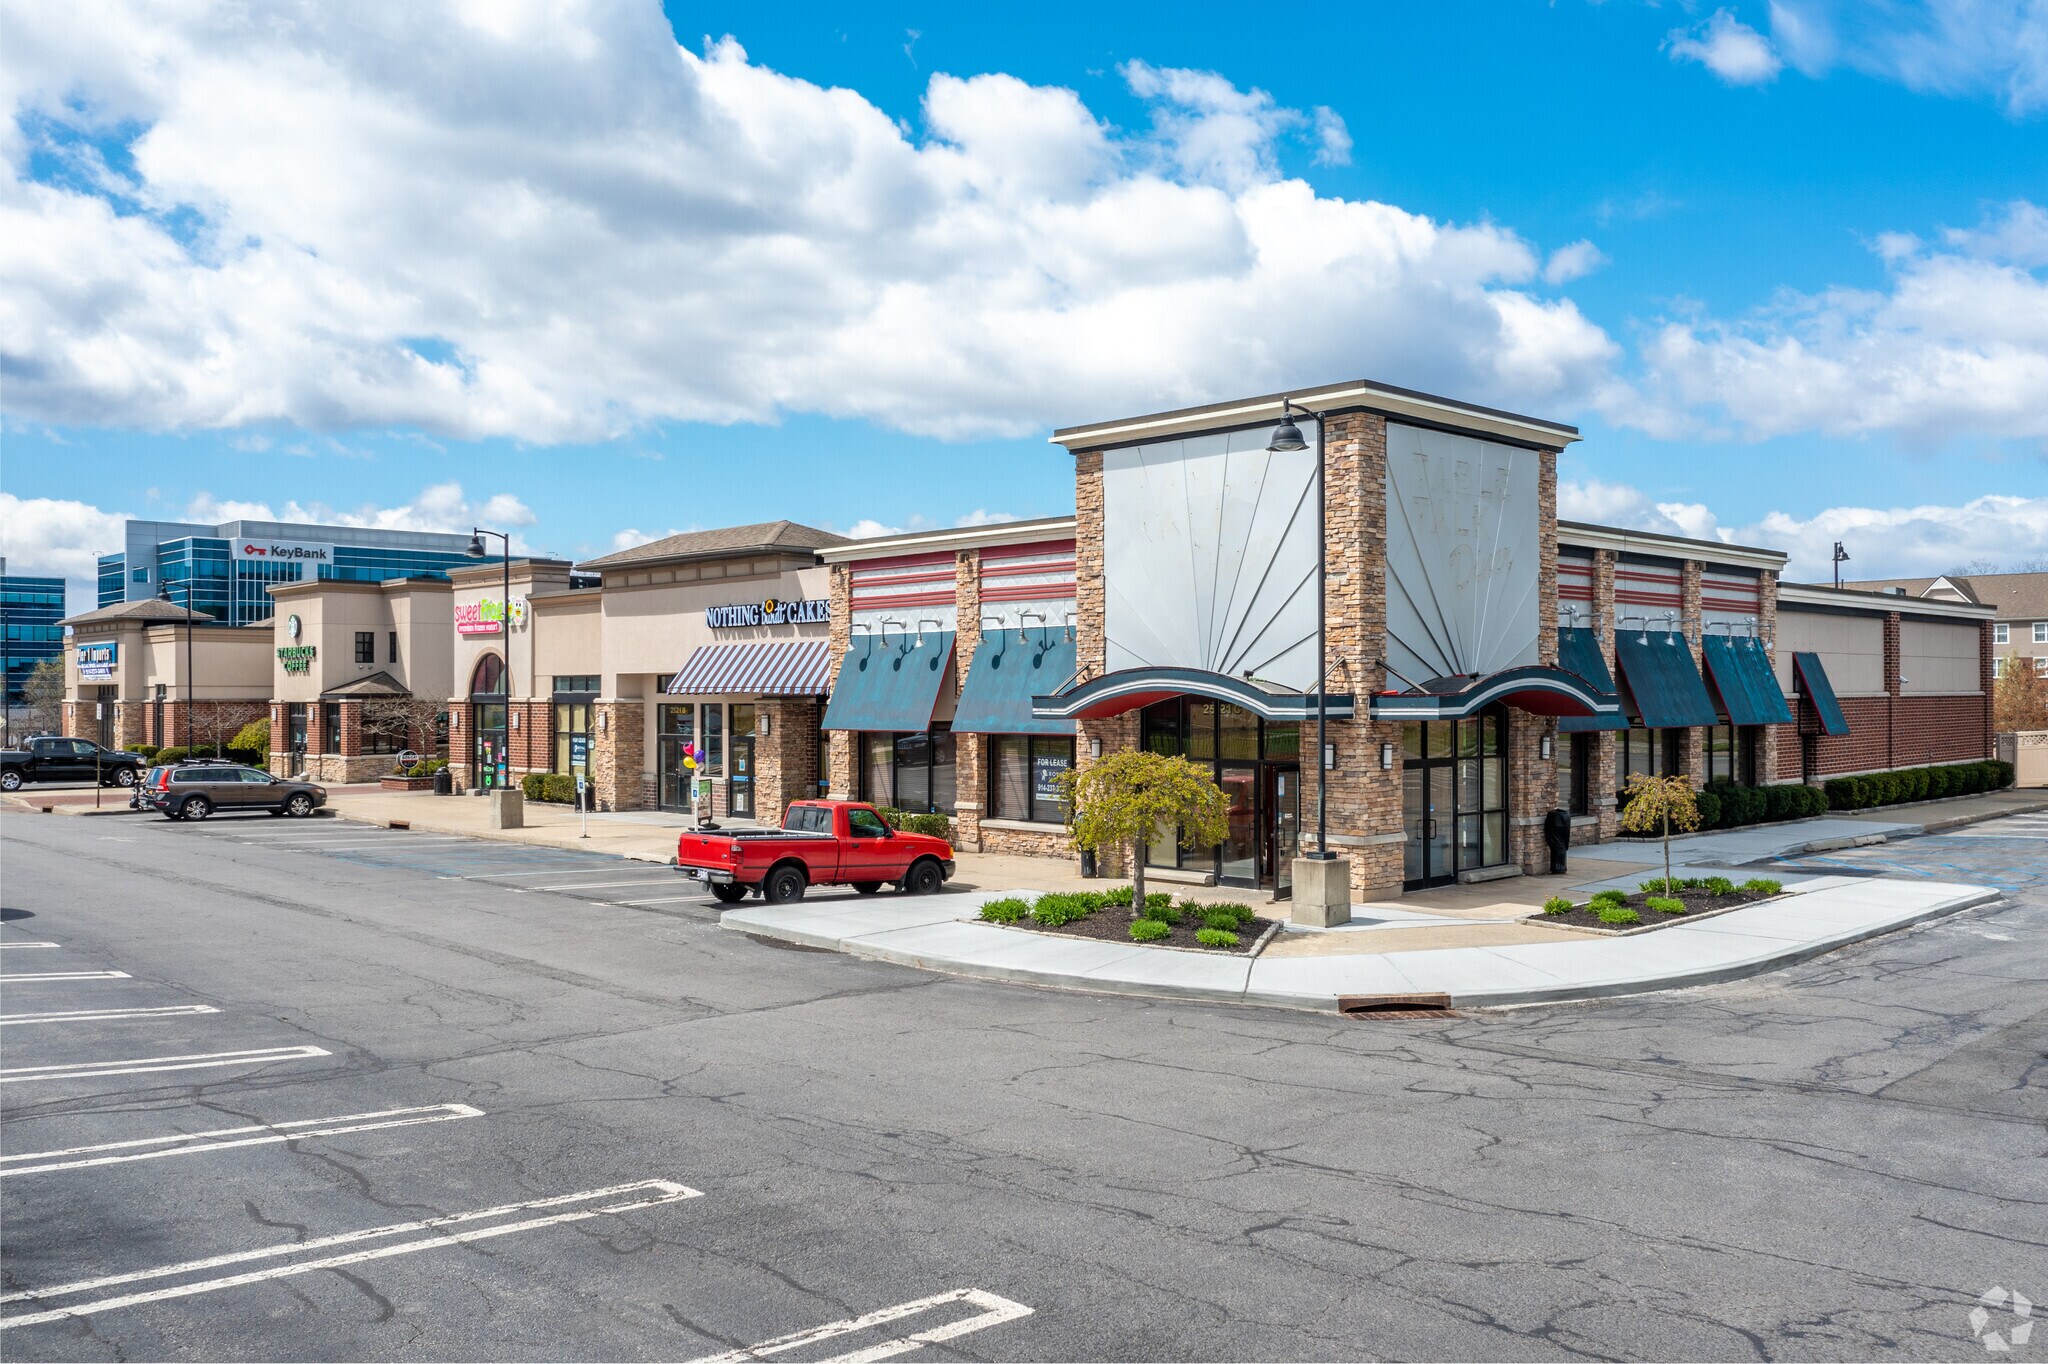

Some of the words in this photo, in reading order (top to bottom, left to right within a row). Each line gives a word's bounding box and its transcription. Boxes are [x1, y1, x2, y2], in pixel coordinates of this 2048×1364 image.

[271, 546, 327, 559] KeyBank
[705, 605, 759, 627] NOTHING
[760, 600, 786, 625] bundt
[787, 601, 830, 623] CAKES
[277, 646, 315, 658] STARBUCKS
[284, 659, 307, 672] COFFEE
[1037, 758, 1049, 767] FOR
[1050, 759, 1068, 767] LEASE
